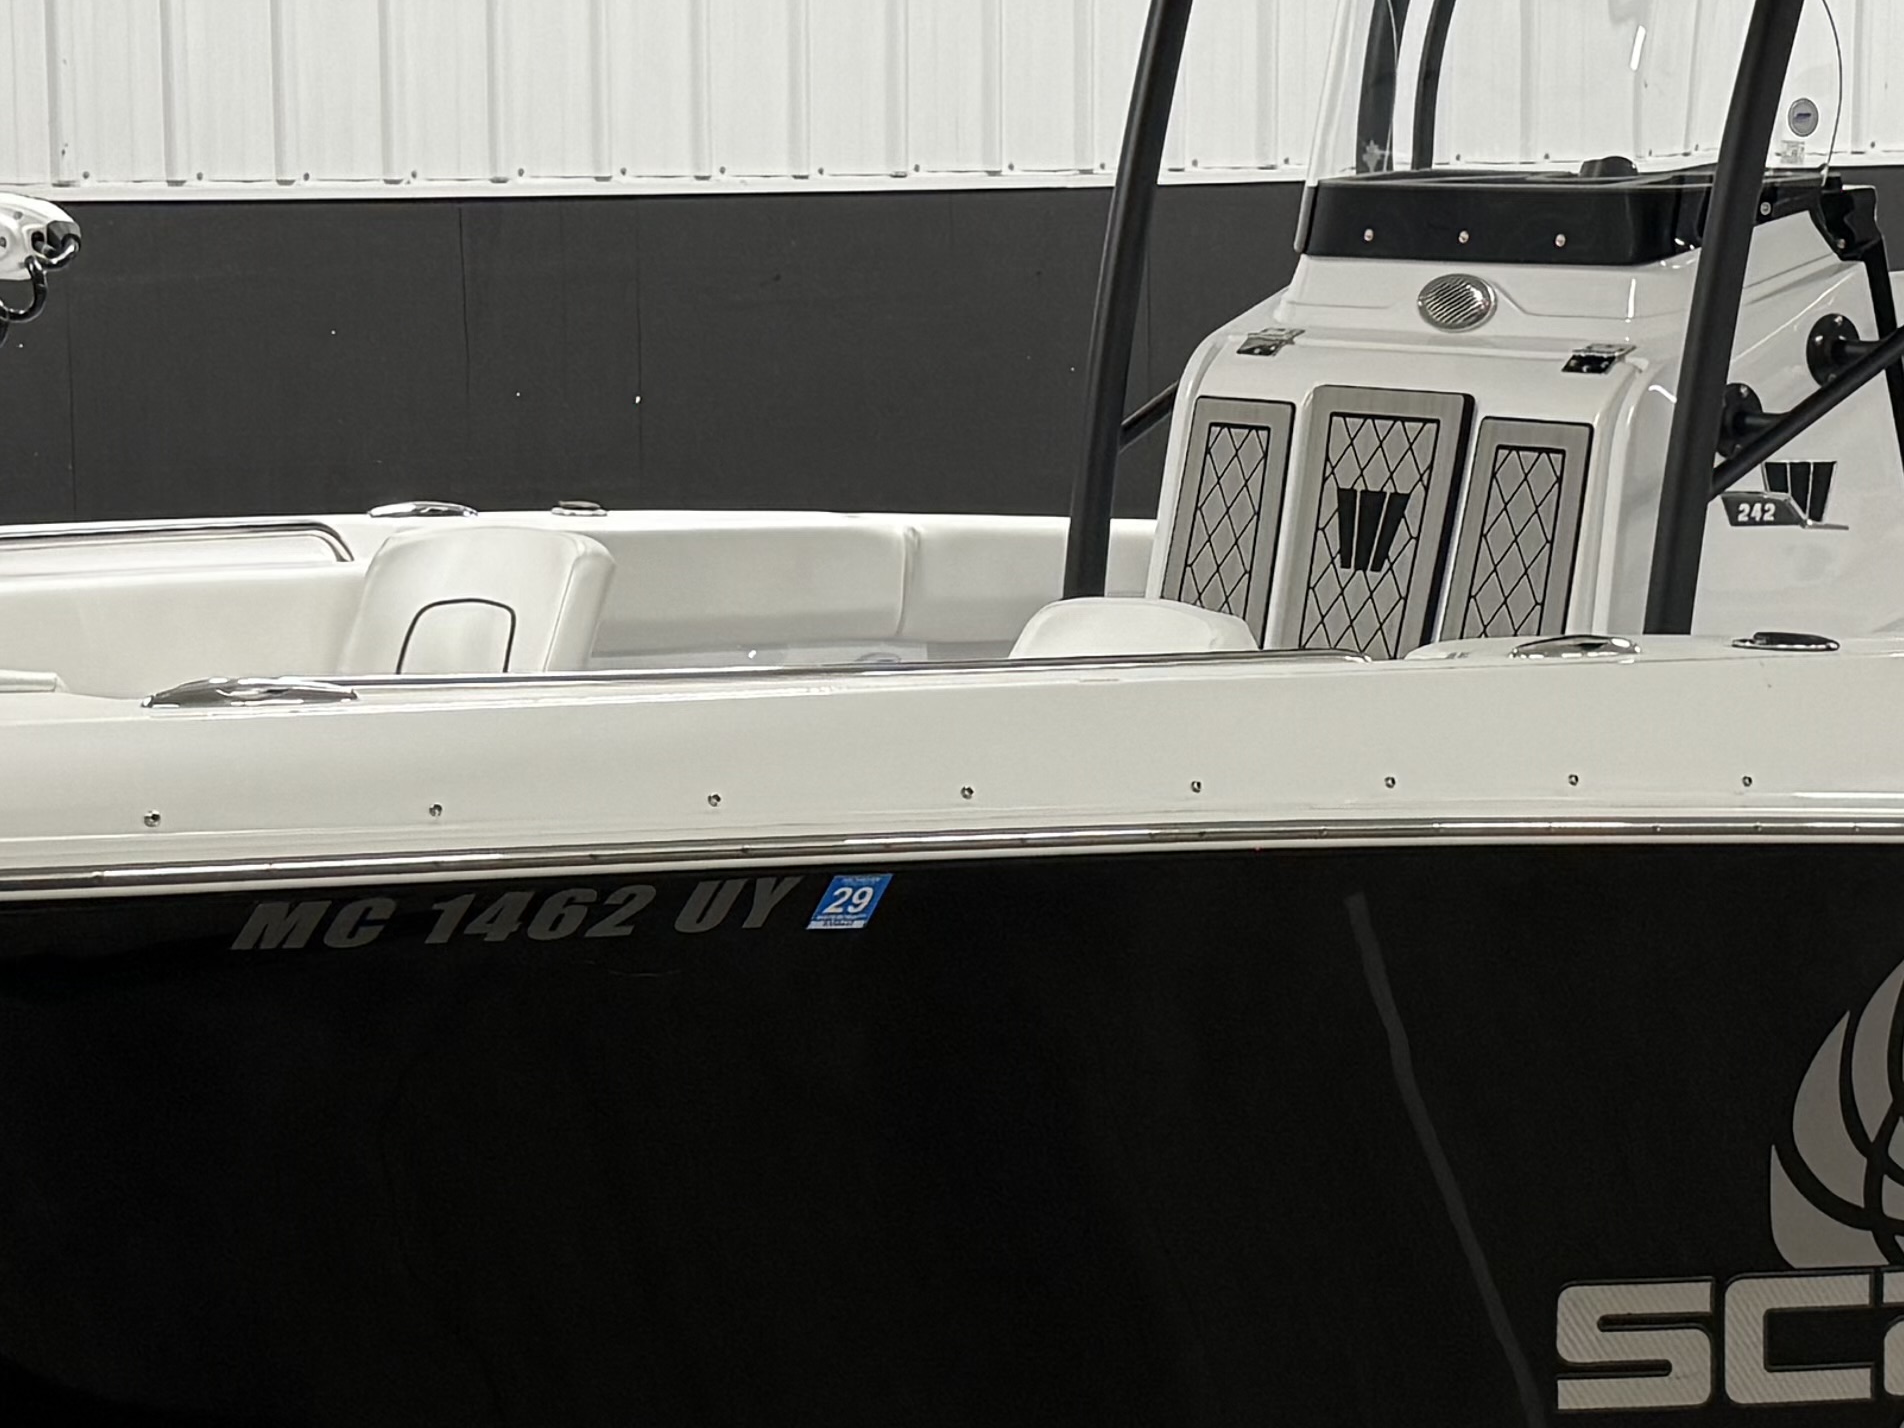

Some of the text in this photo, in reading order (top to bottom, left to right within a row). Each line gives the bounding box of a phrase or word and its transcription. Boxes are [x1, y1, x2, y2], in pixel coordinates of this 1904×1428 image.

[1737, 503, 1776, 522] 242
[231, 875, 806, 950] MC 1462 UY
[822, 886, 874, 914] 29
